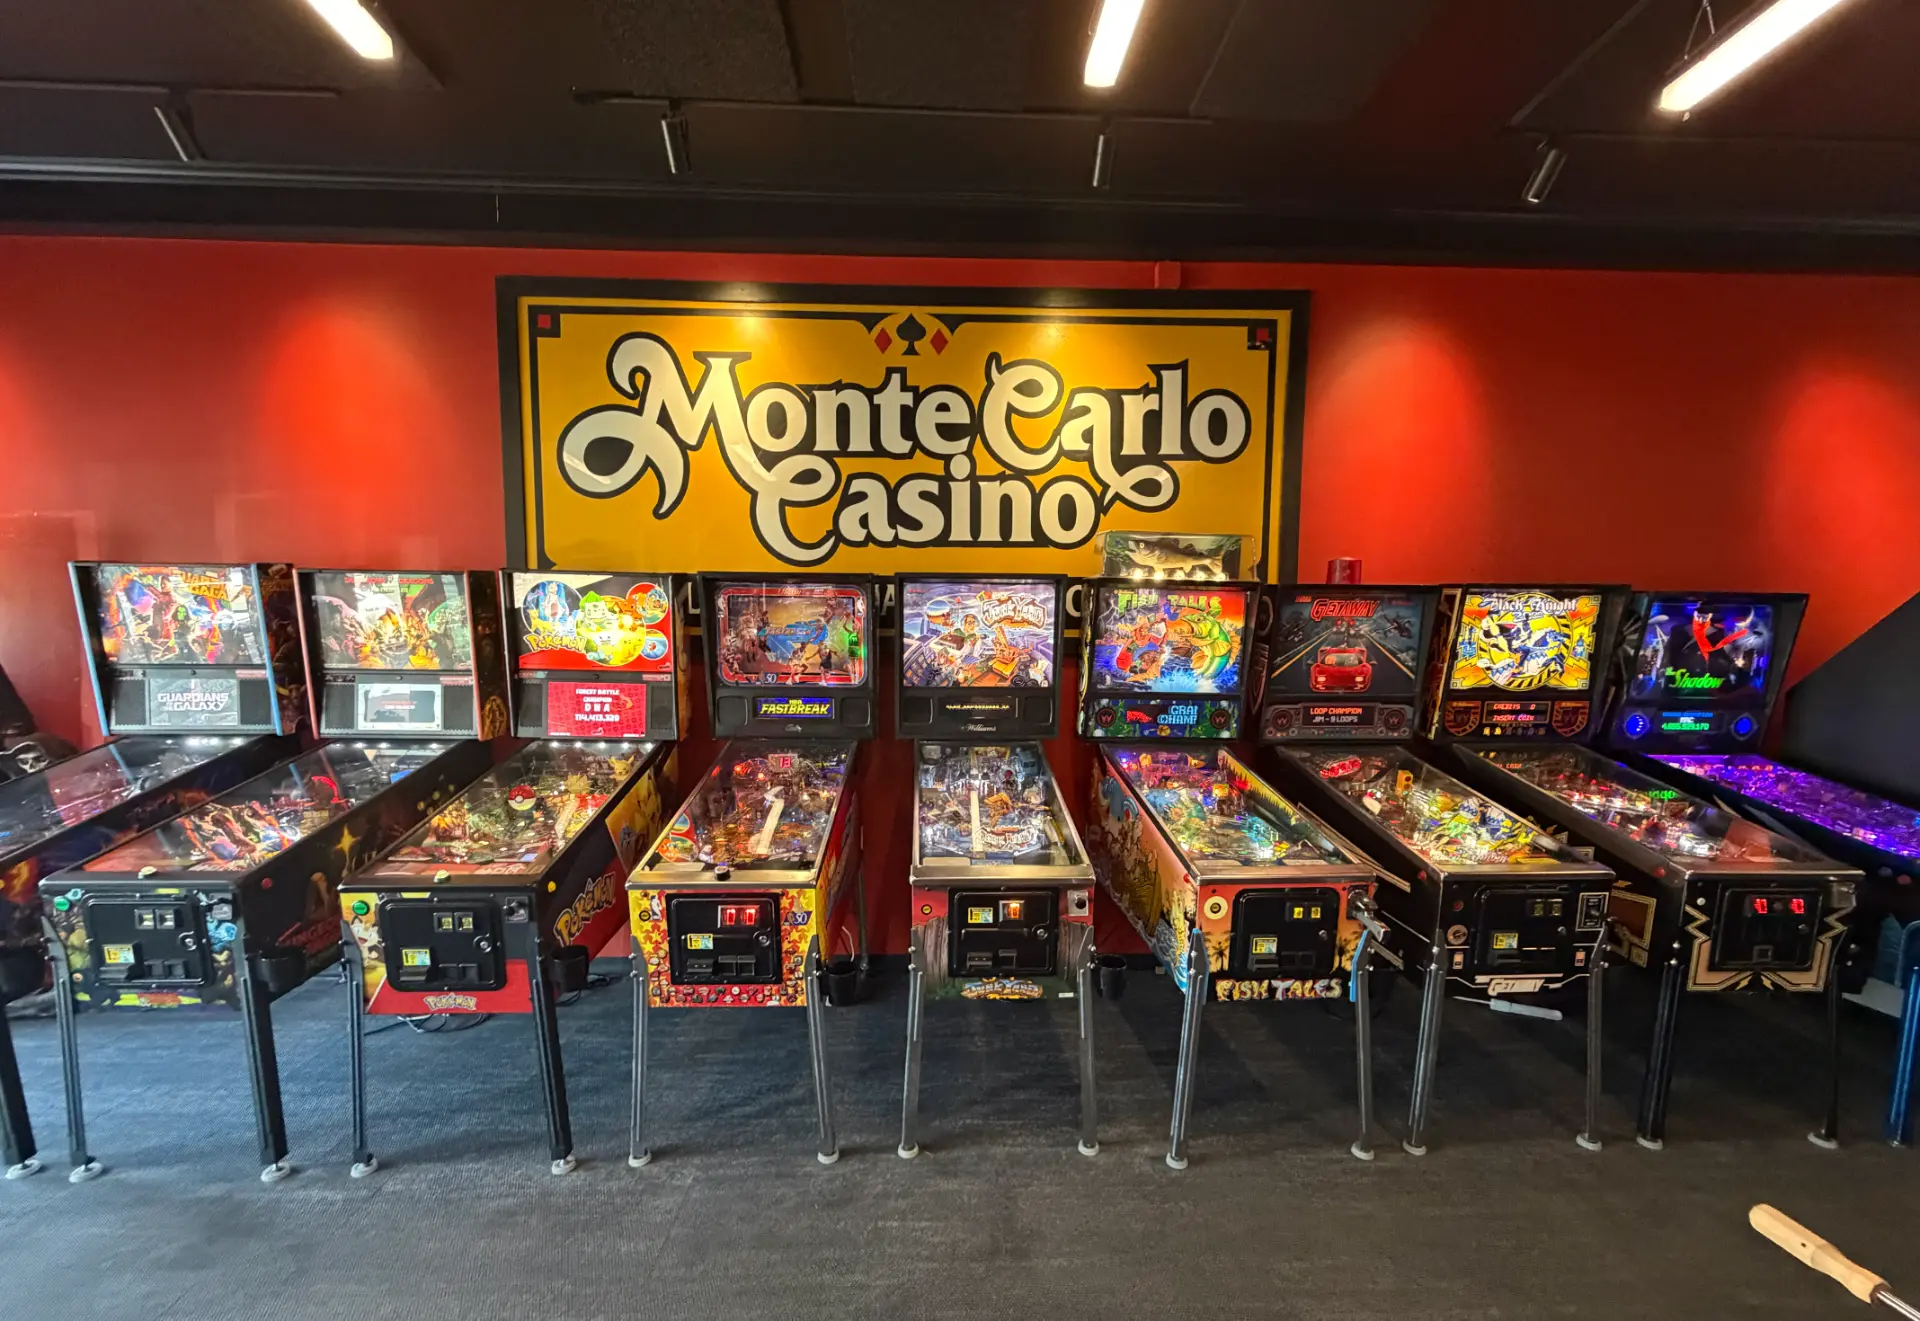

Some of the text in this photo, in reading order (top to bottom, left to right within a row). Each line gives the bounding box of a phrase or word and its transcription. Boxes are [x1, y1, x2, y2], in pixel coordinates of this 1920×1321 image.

[556, 332, 1251, 517] Monte Carlo
[751, 454, 1101, 566] Casino
[1118, 593, 1222, 618] FISH TALES
[1310, 598, 1380, 622] GETAWAY
[1669, 669, 1725, 689] Shadow
[157, 692, 229, 703] GUARDIANS
[173, 701, 226, 711] GALAXY
[760, 703, 830, 715] FASTBREAK
[1310, 707, 1363, 715] LOOP CHAMPION
[1336, 715, 1358, 723] LOOPS
[1215, 978, 1343, 1002] FISH TALES
